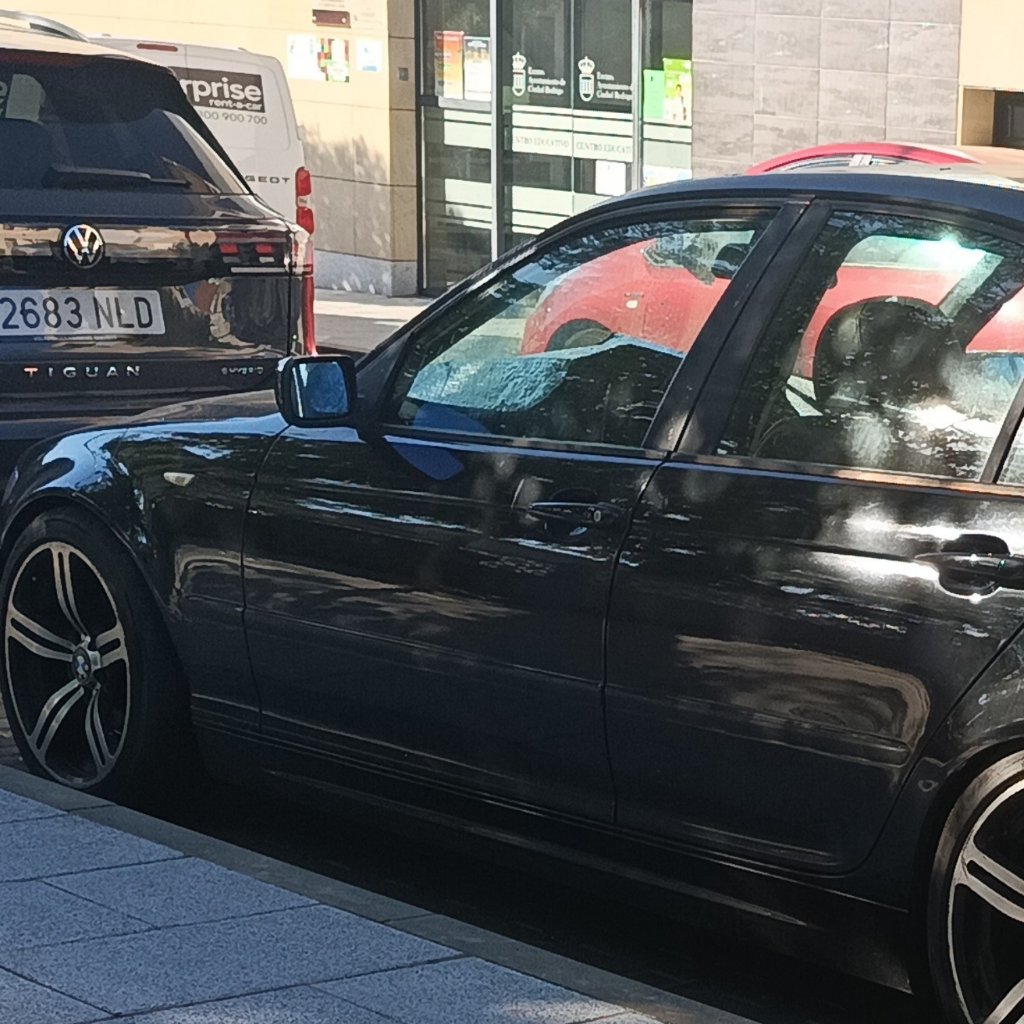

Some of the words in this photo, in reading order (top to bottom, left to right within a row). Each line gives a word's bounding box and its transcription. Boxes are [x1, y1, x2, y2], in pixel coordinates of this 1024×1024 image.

[180, 77, 262, 102] rprise
[209, 99, 262, 110] rent-a-car
[222, 112, 244, 122] 900
[246, 115, 267, 125] 700
[0, 296, 83, 330] 2683
[94, 296, 154, 329] NLD
[24, 365, 140, 378] TIGUAN
